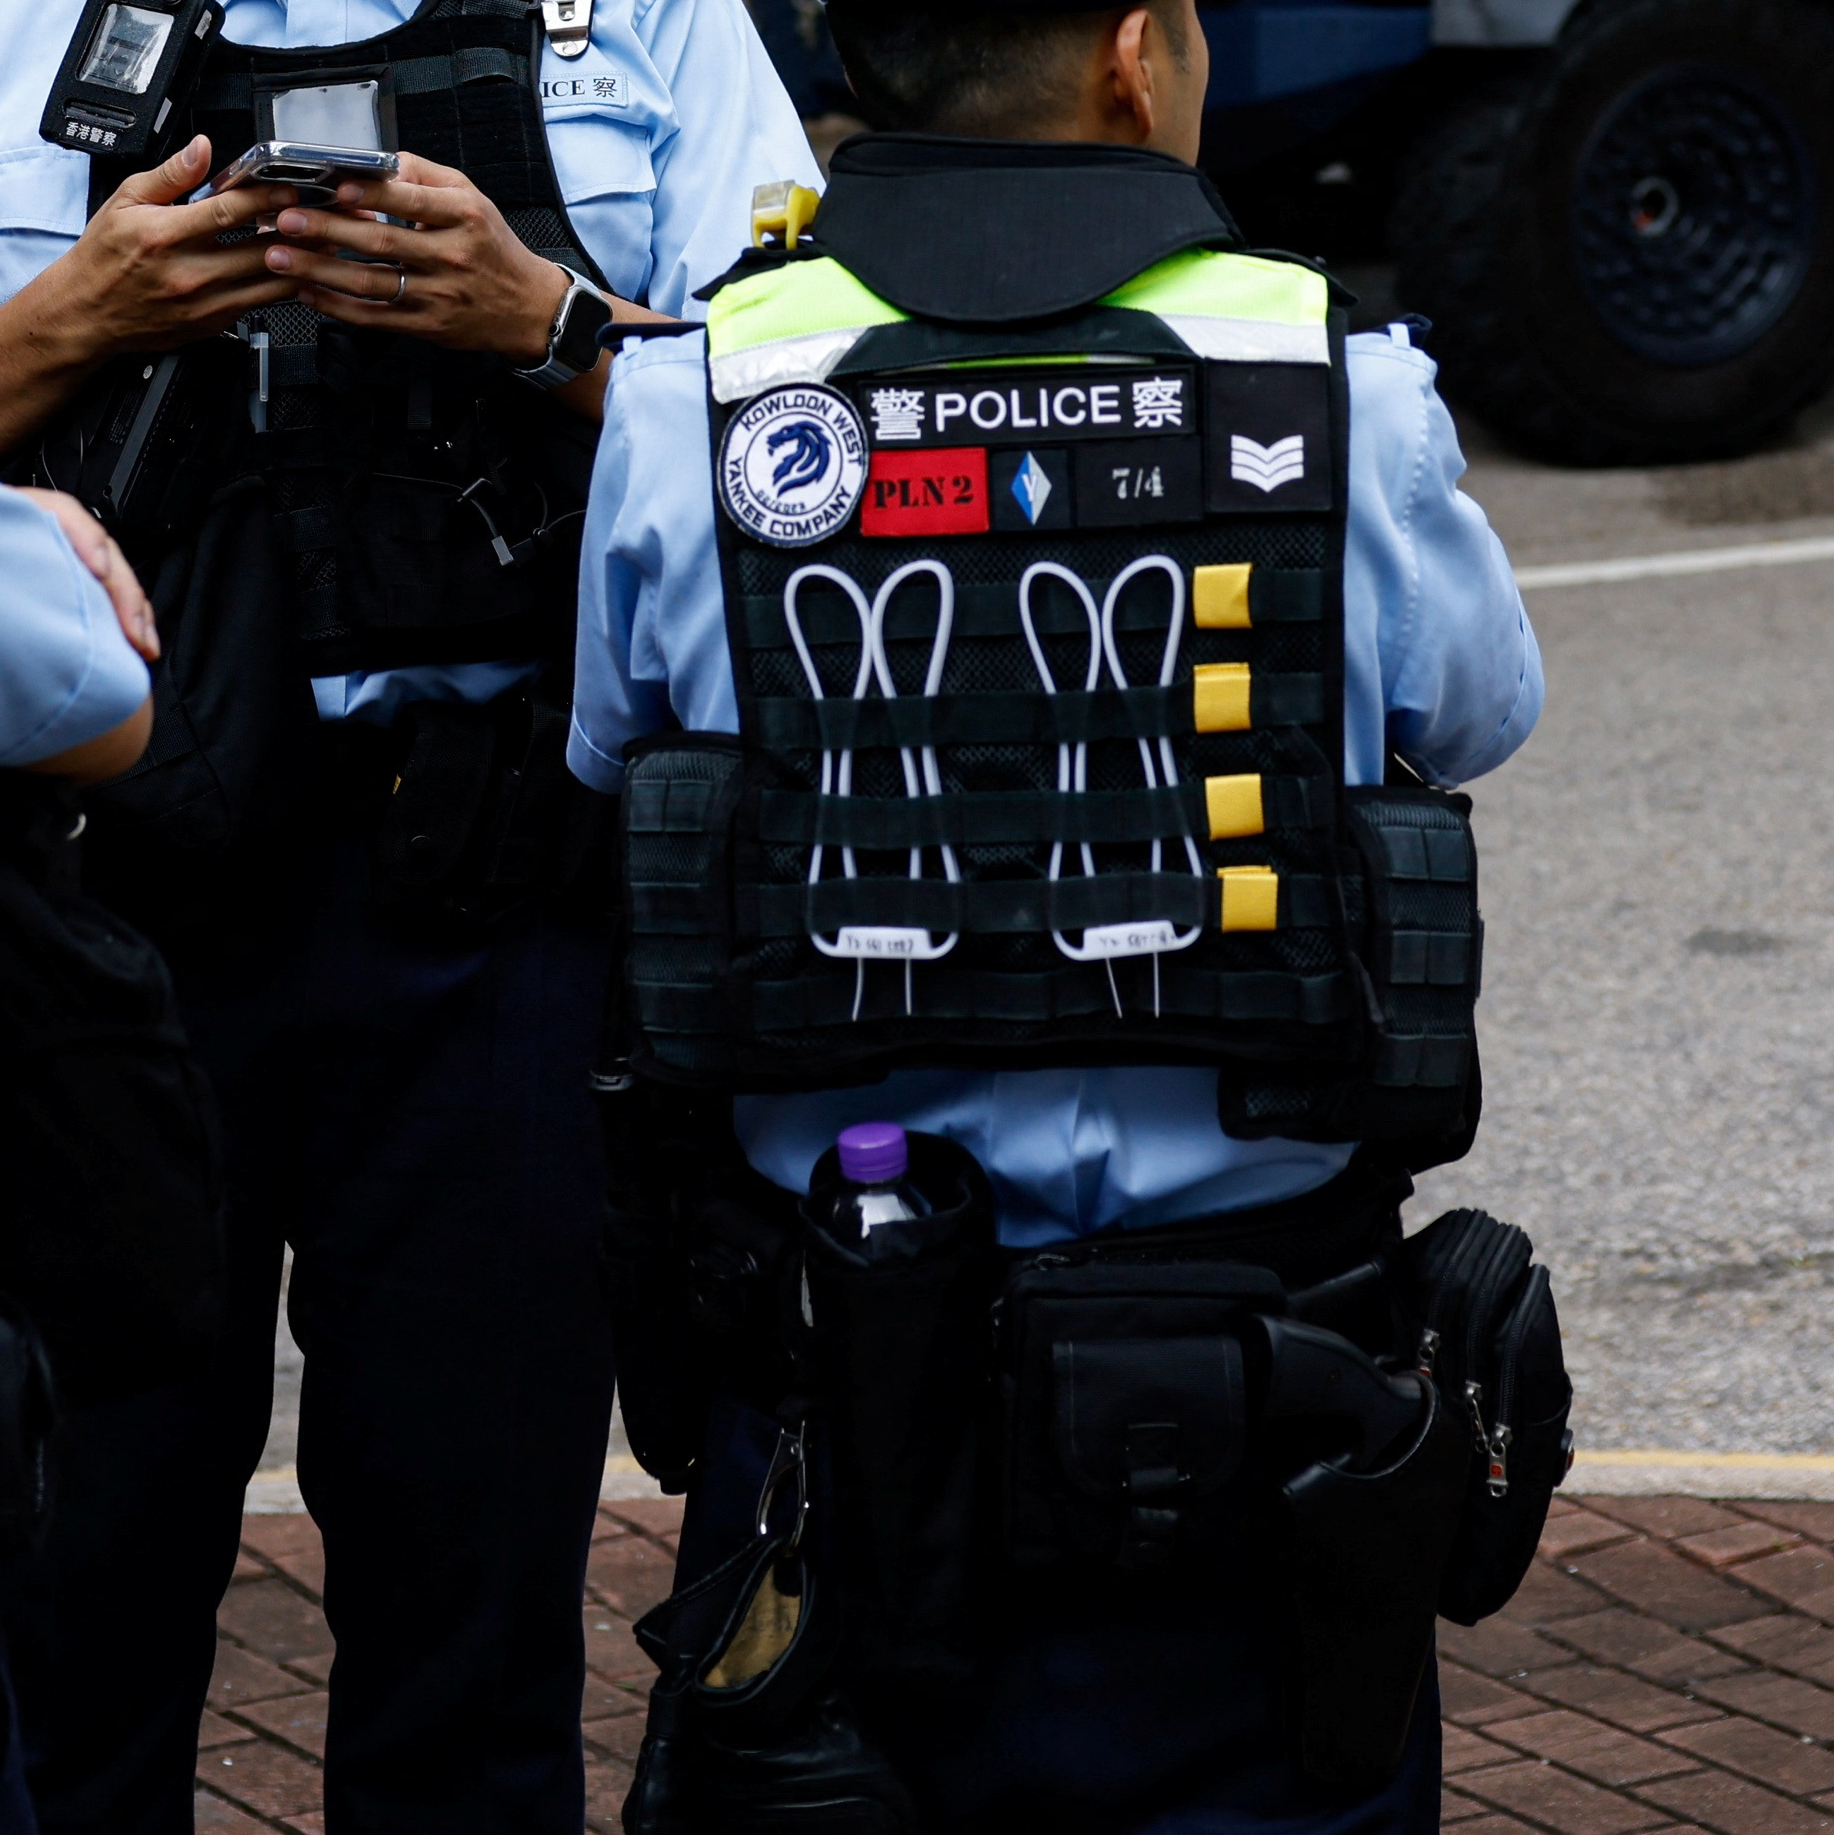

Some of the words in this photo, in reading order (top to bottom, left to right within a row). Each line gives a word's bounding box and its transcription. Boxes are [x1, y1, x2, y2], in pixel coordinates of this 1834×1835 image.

[541, 79, 586, 98] ICE
[592, 76, 618, 98] 察
[66, 121, 117, 147] 香港警察
[739, 394, 833, 432] KOWLOON
[833, 411, 864, 467] WEST
[870, 387, 925, 441] 警
[935, 385, 1122, 432] POLICE
[1132, 376, 1183, 428] 察
[729, 456, 767, 529] YANKEE
[769, 485, 852, 537] COMPANY
[1111, 466, 1165, 500] 7/4
